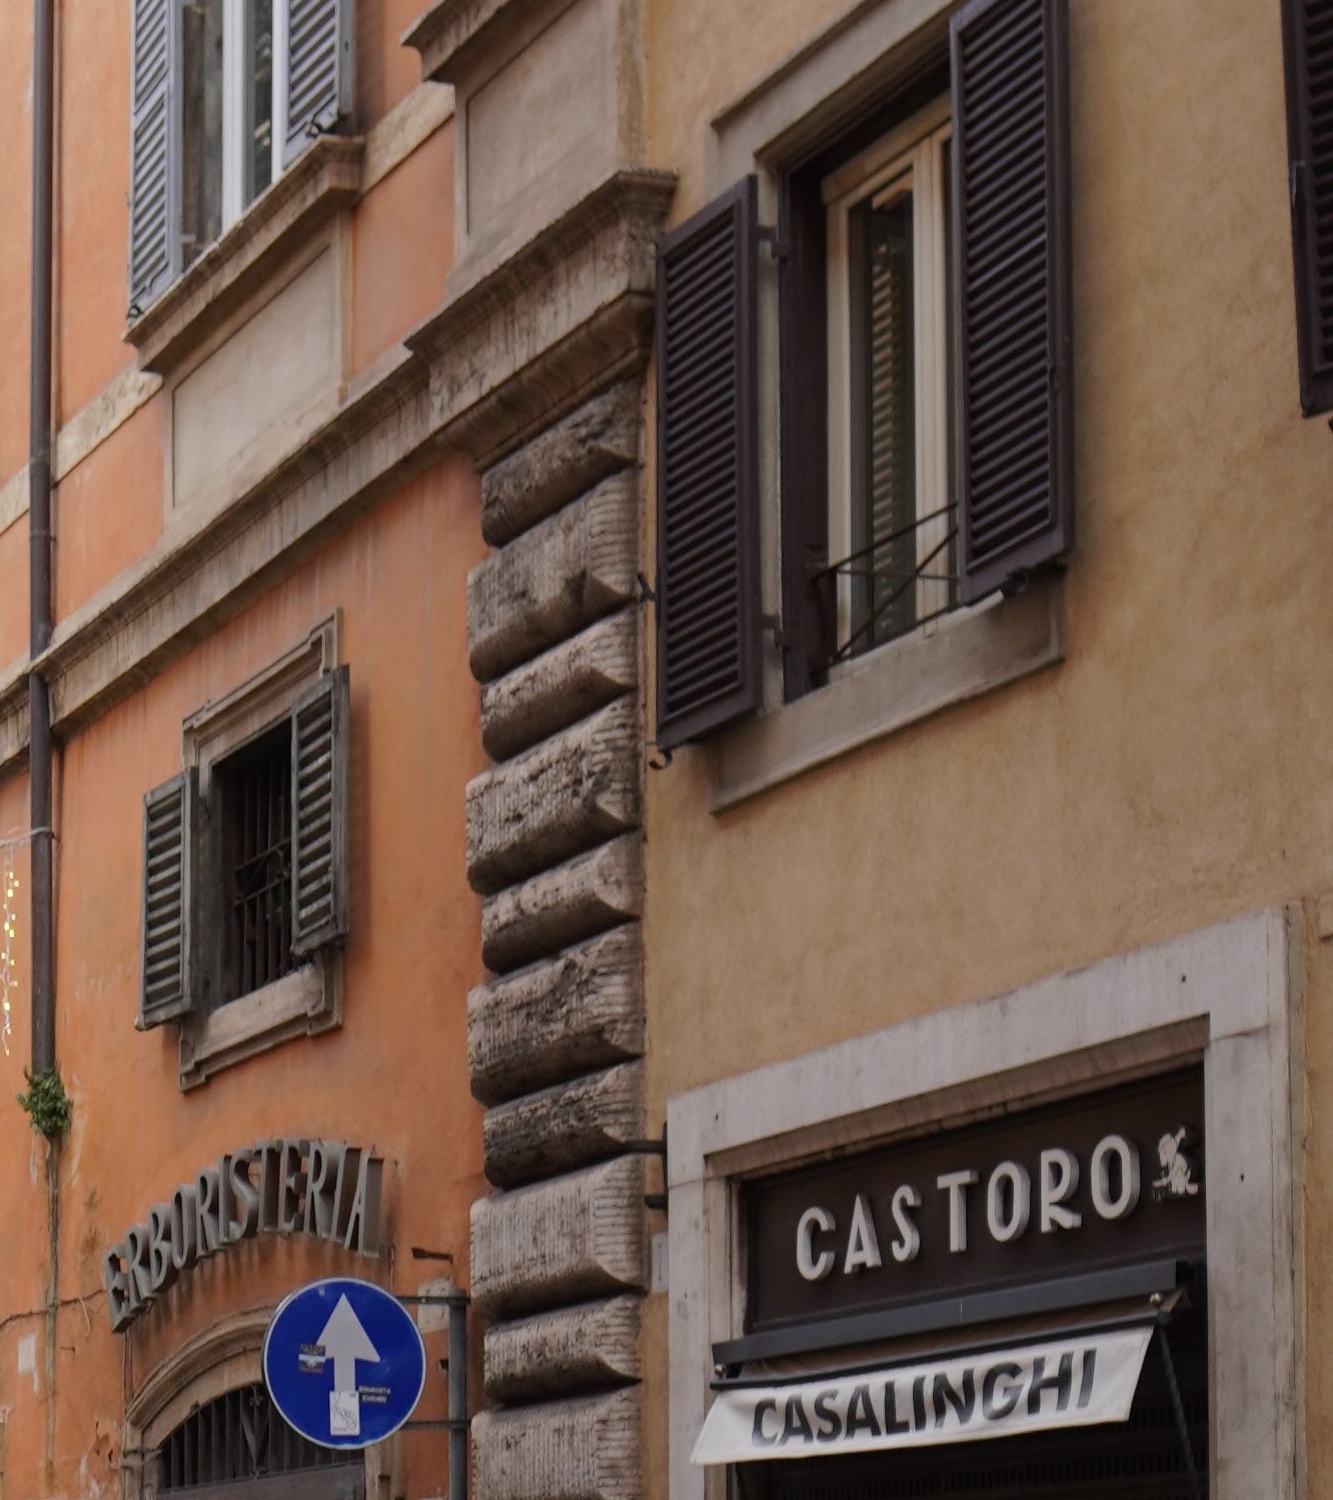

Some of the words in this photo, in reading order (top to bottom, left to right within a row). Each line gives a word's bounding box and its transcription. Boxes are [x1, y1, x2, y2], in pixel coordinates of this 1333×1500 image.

[103, 1139, 385, 1333] ERBORISTERIA
[796, 1133, 1141, 1282] CASTORO
[752, 1347, 1097, 1446] CASALINGHI
